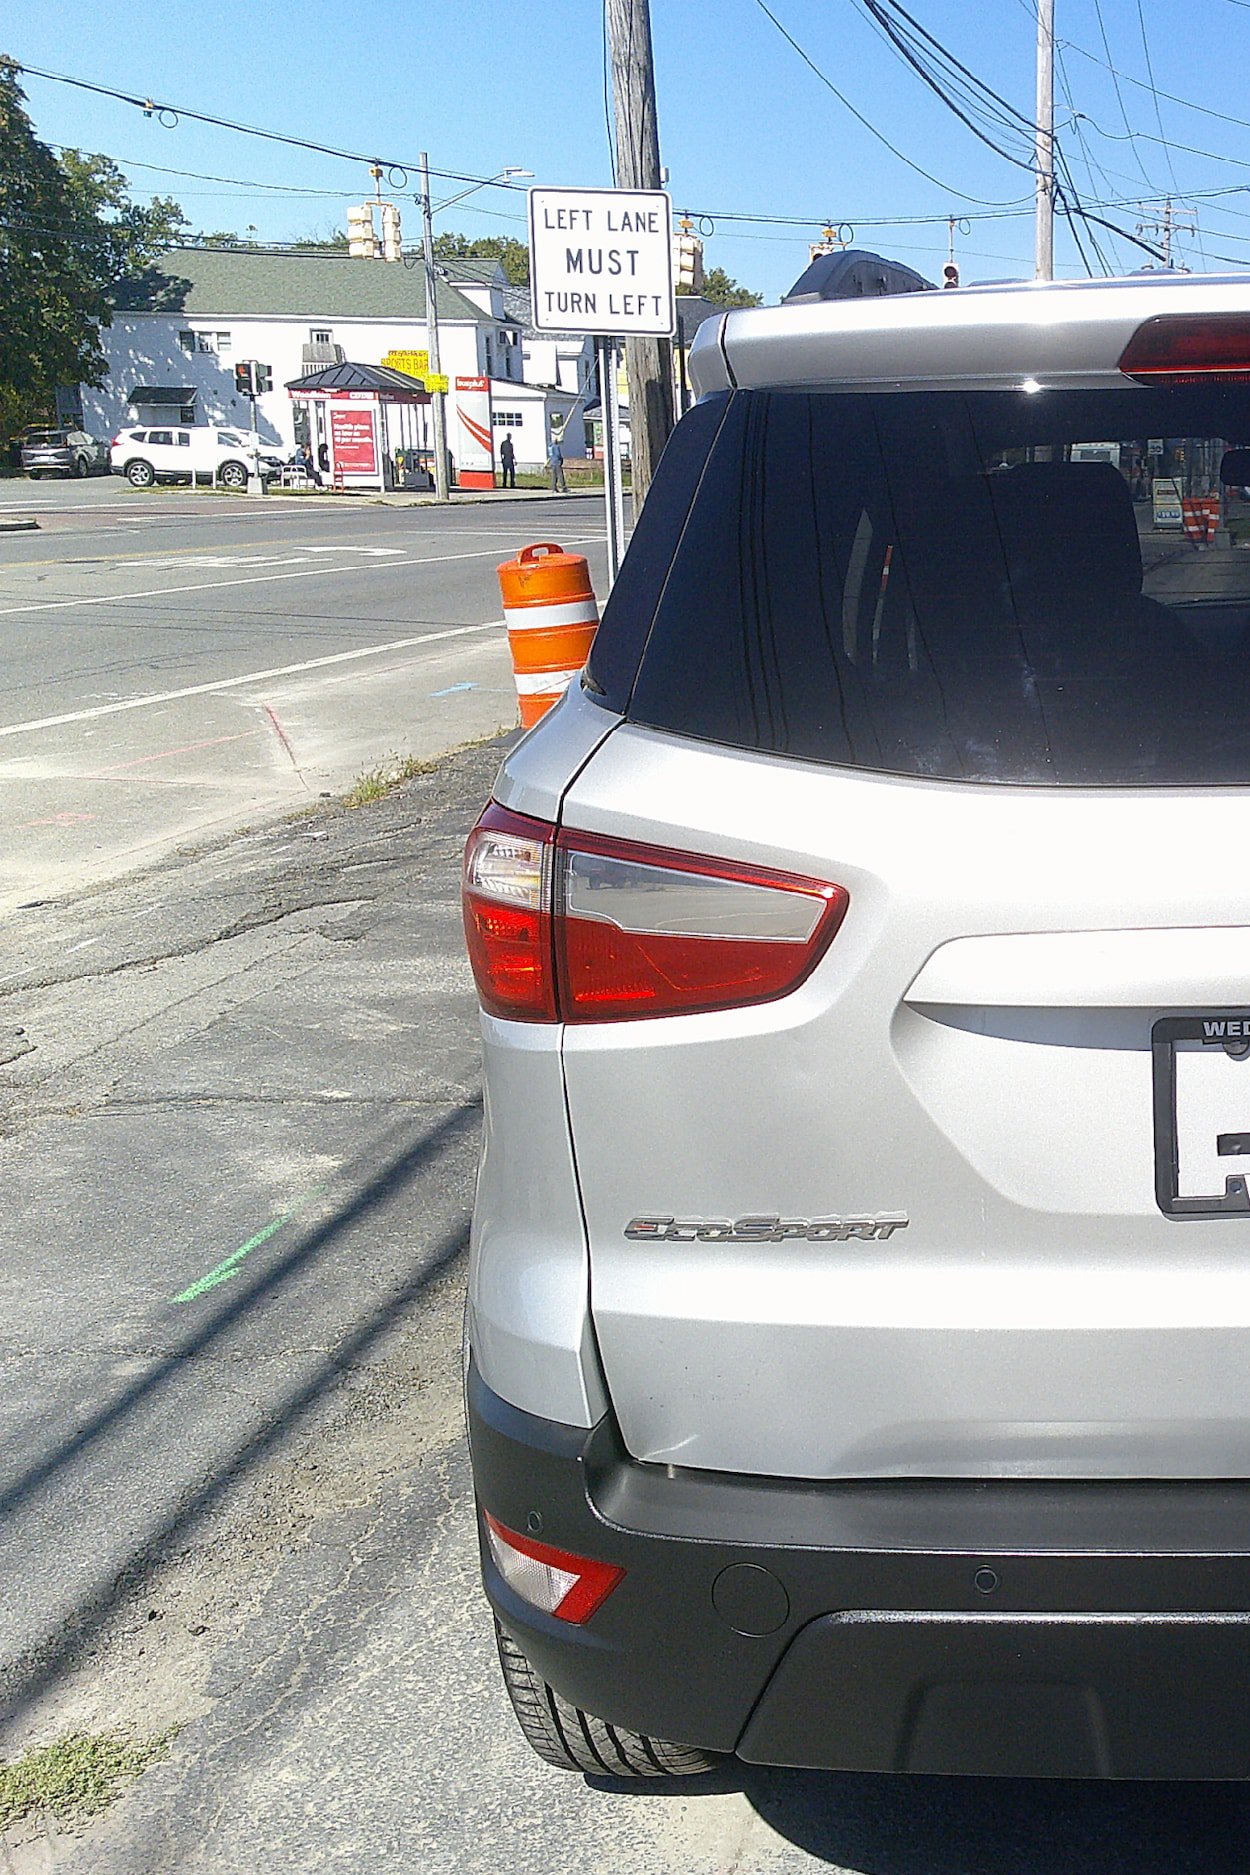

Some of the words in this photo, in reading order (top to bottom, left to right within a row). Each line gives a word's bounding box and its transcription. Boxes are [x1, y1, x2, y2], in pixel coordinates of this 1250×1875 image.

[544, 208, 593, 231] LEFT
[607, 210, 660, 233] LANE
[565, 247, 639, 276] MUST
[544, 291, 597, 314] TURN
[609, 294, 662, 316] LEFT
